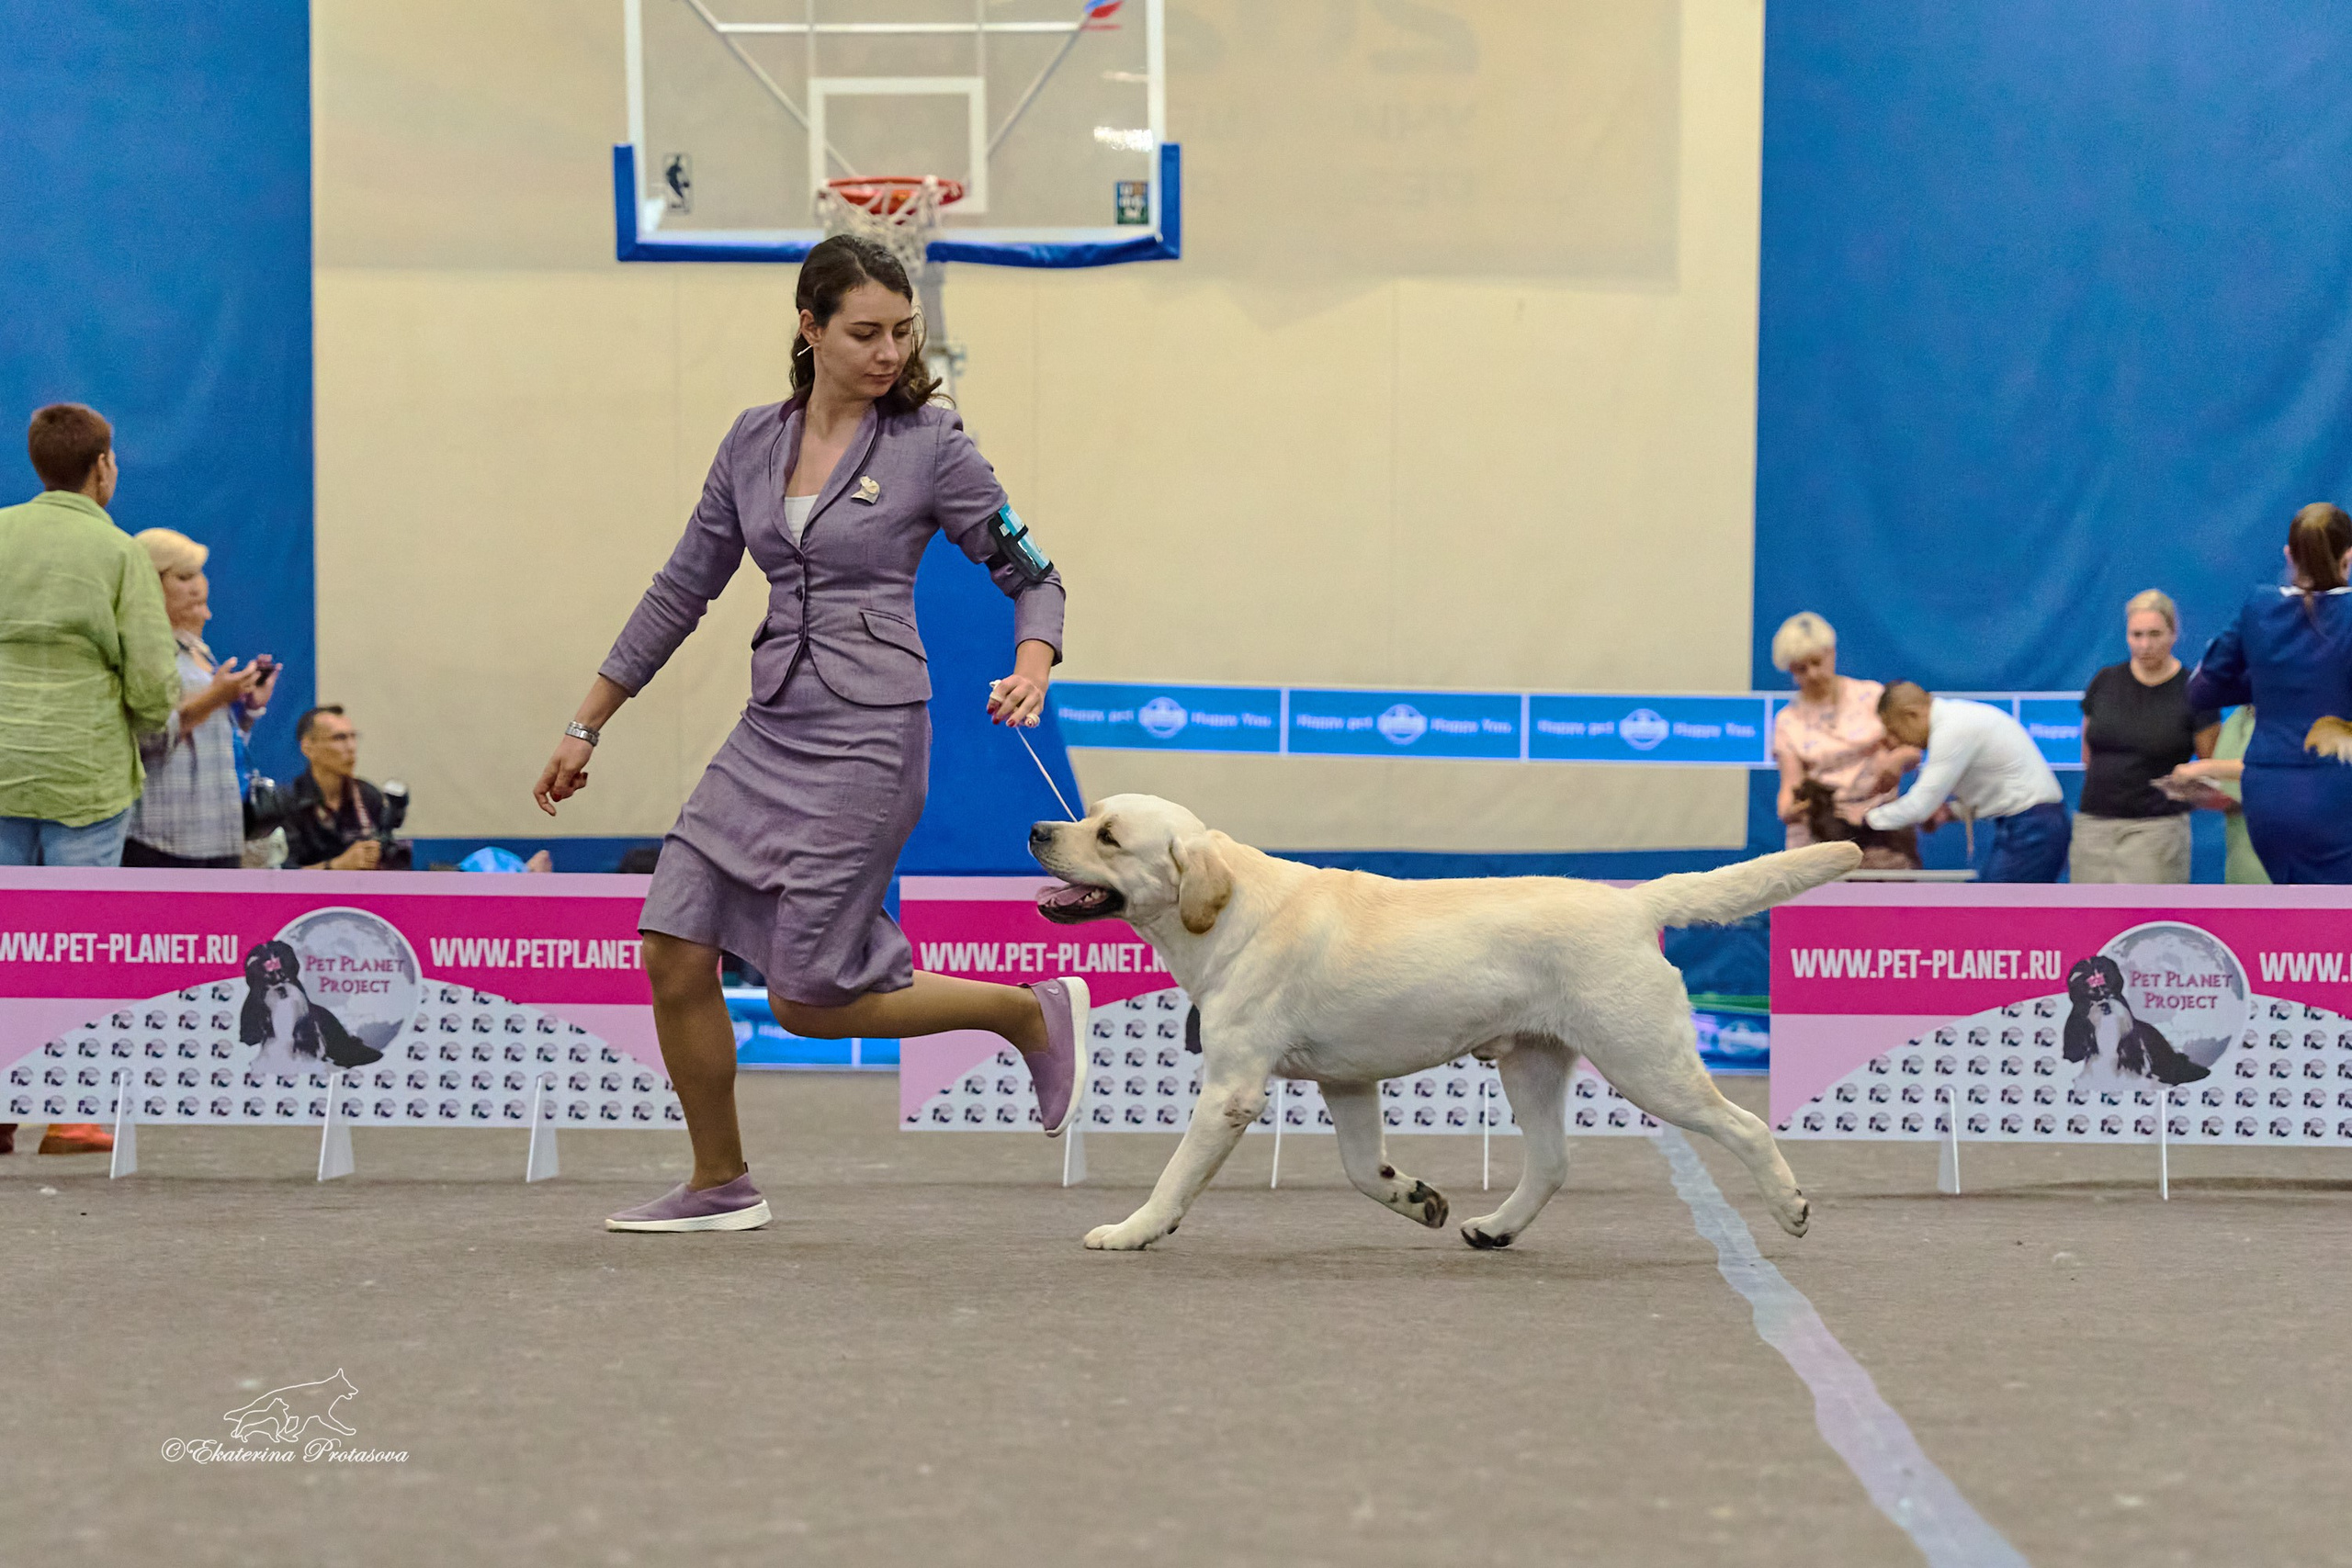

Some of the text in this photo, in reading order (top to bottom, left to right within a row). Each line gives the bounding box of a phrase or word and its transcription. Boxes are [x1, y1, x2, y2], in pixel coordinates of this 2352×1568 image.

[429, 937, 643, 969] WWW.PETPLANET
[339, 955, 405, 972] PLANET
[1791, 948, 2062, 980] WWW.PET-PLANET.RU
[2259, 952, 2352, 983] WWW.
[318, 976, 390, 994] PROJECT
[2165, 970, 2233, 987] PLANET
[2143, 992, 2218, 1010] PROJECT
